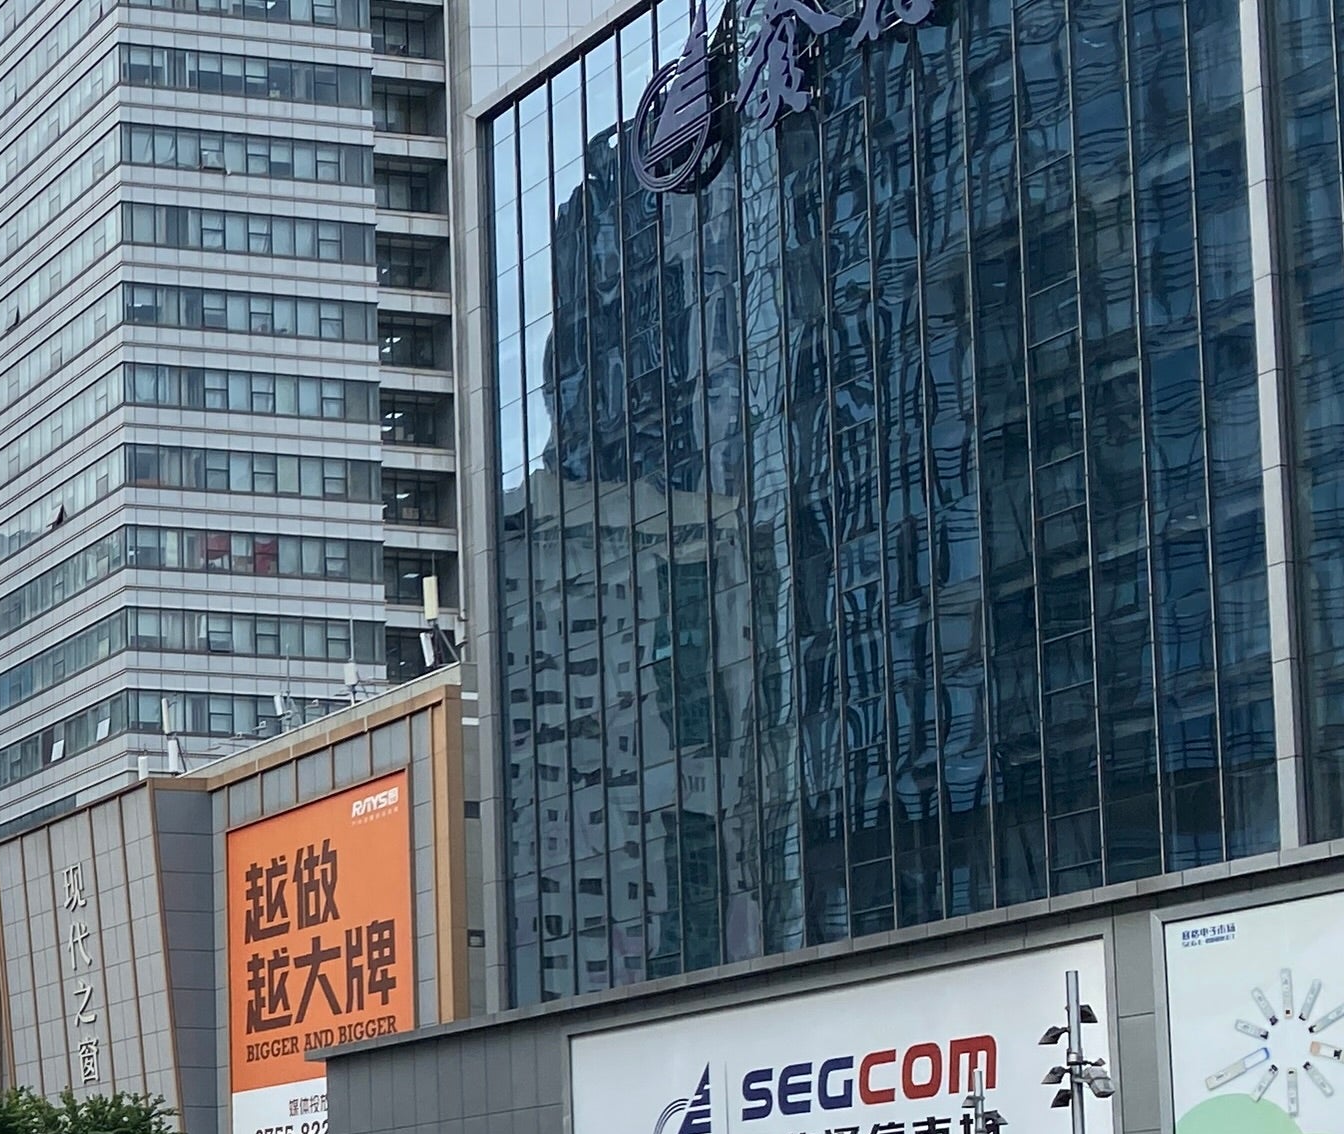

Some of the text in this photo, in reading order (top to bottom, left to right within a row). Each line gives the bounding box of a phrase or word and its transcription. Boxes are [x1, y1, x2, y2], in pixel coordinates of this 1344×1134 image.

[244, 838, 341, 945] 越做
[62, 861, 101, 1085] 现代之窗
[246, 918, 398, 1035] 越大牌
[246, 1015, 398, 1062] BIGGER AND BIGGER
[742, 1034, 997, 1121] SEGCOM
